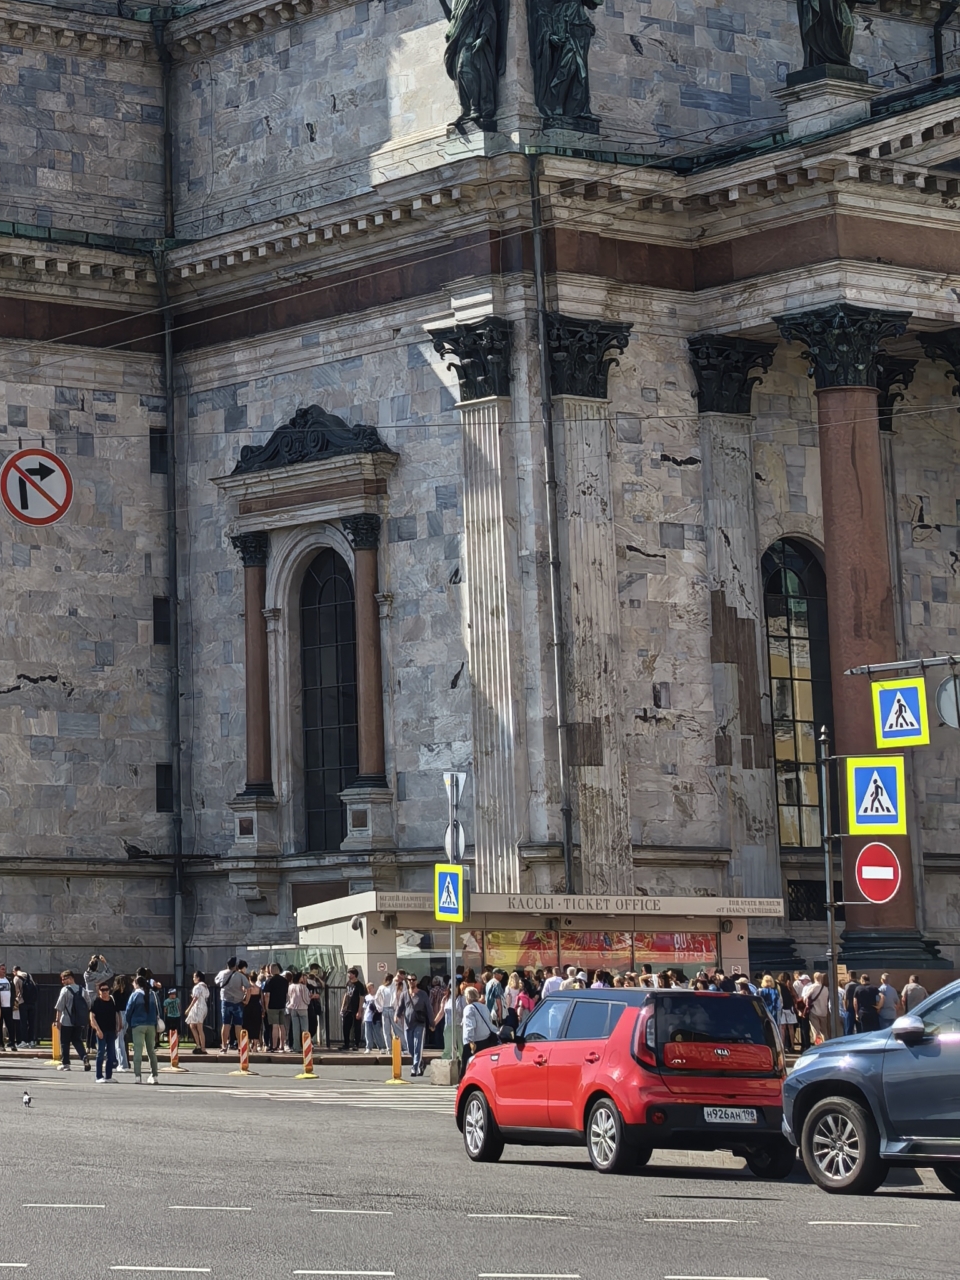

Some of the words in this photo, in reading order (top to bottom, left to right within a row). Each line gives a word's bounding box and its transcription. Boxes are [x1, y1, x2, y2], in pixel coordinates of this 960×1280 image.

[507, 897, 554, 910] КАССЫ
[563, 898, 611, 910] TICKET
[615, 899, 661, 911] OFFICE
[706, 1108, 740, 1120] Н926АН
